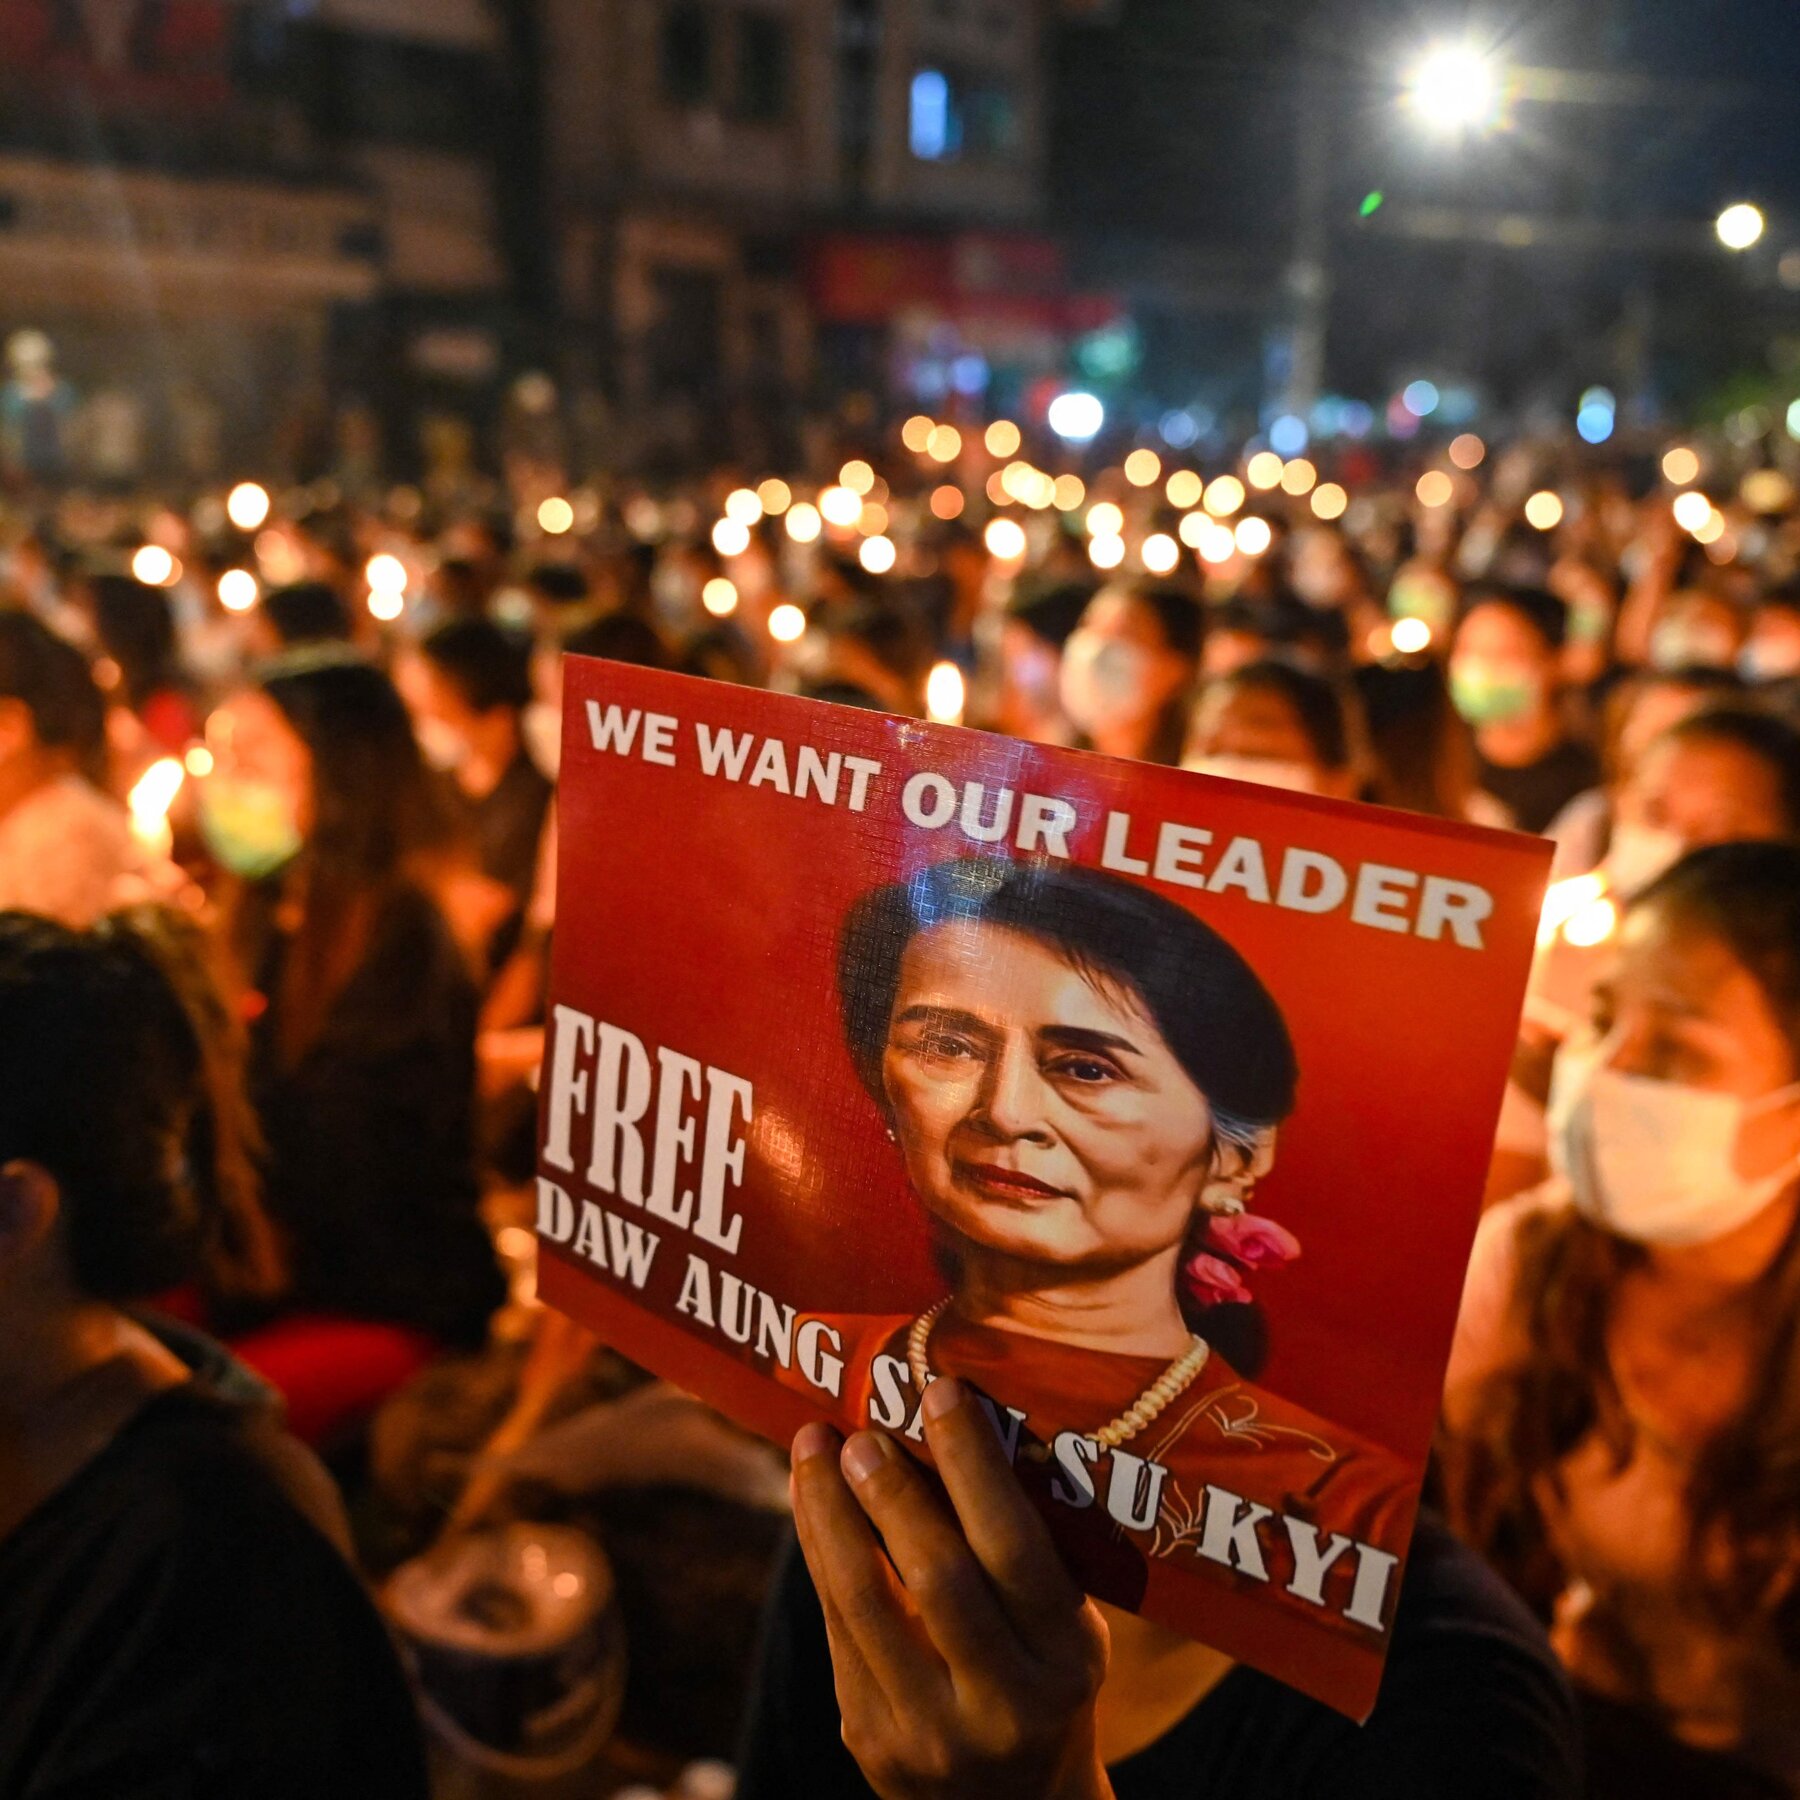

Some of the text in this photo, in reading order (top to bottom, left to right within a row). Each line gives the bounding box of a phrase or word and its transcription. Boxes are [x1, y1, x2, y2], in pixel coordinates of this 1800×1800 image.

[585, 699, 1494, 950] WE WANT OUR LEADER
[543, 1003, 754, 1255] FREE
[536, 1176, 660, 1290] DAW
[675, 1254, 845, 1399] AUNG
[1051, 1431, 1168, 1531] SU
[1196, 1484, 1399, 1633] KYI
